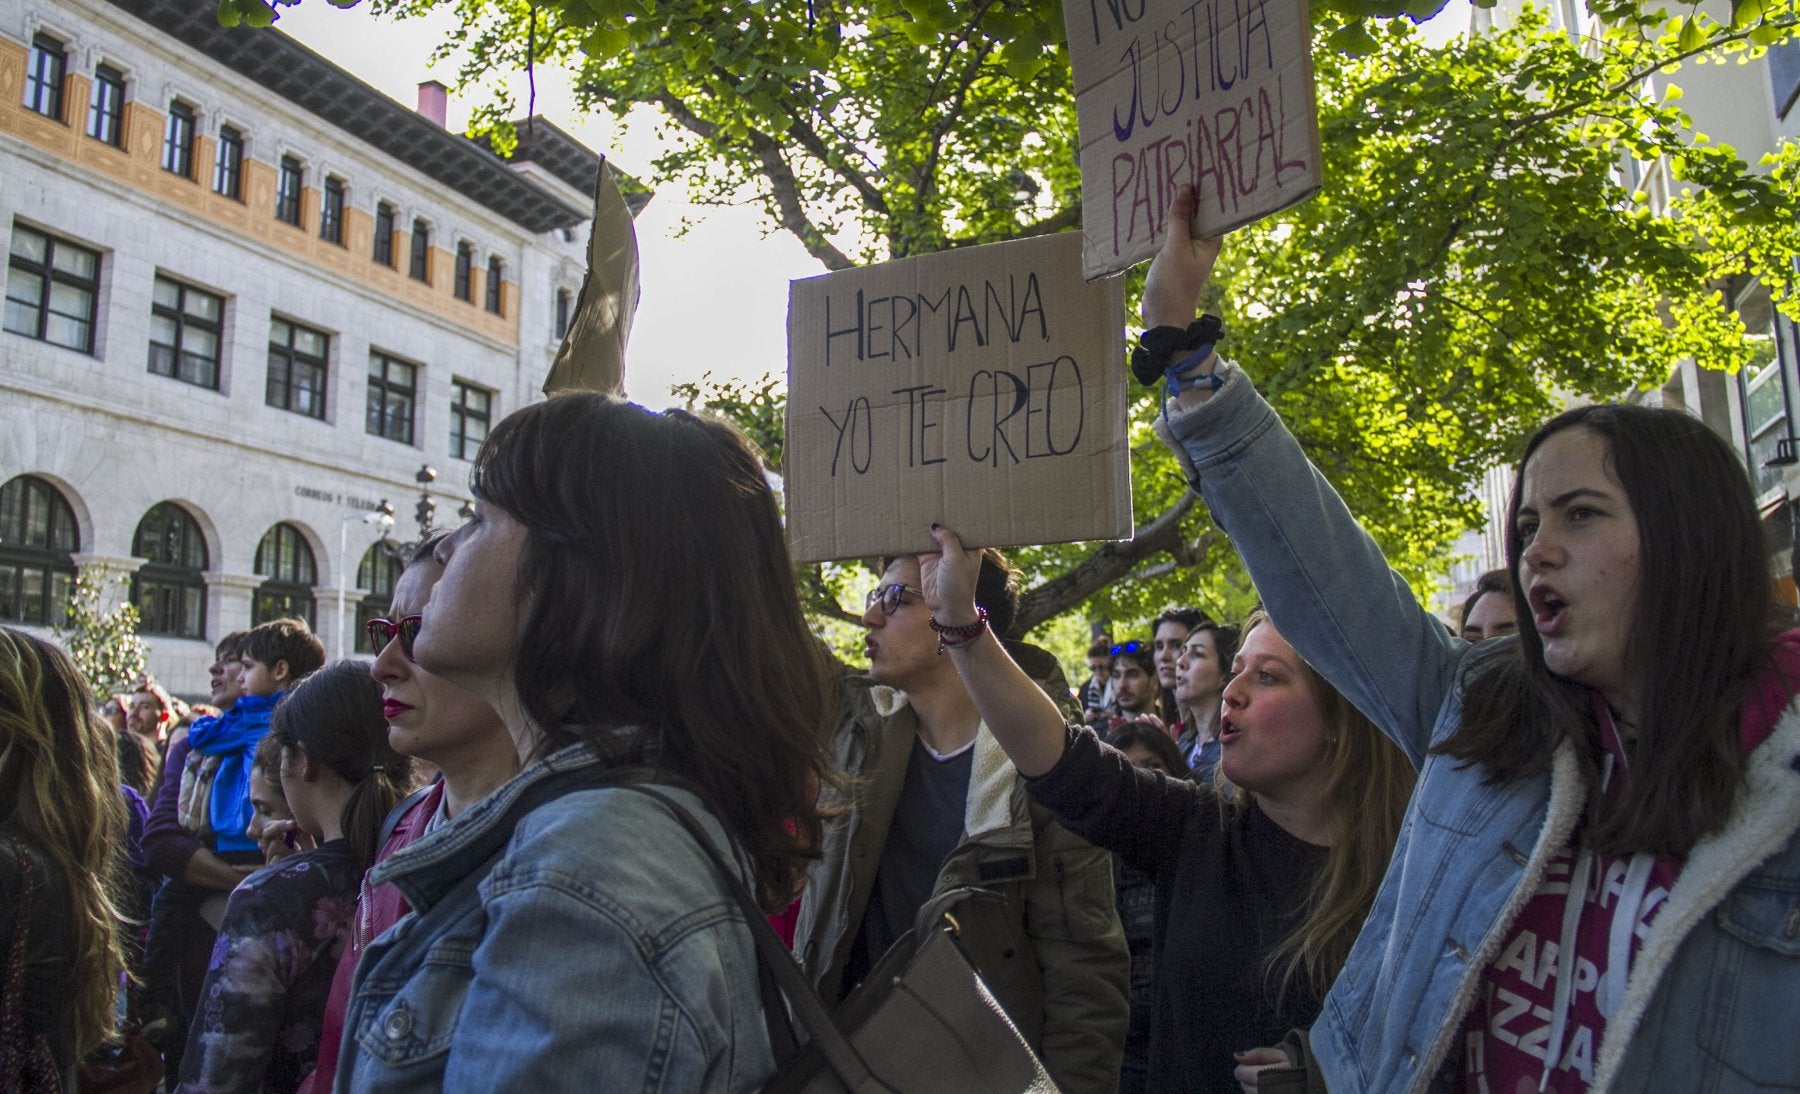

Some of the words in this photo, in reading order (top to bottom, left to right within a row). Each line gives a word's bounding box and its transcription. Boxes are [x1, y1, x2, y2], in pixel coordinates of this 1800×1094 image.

[1090, 0, 1146, 45] N
[1113, 0, 1273, 142] JUSTICIA
[825, 272, 1050, 367] HERMANA,
[818, 396, 872, 477] YO
[891, 384, 948, 467] TE
[966, 355, 1084, 468] CREO
